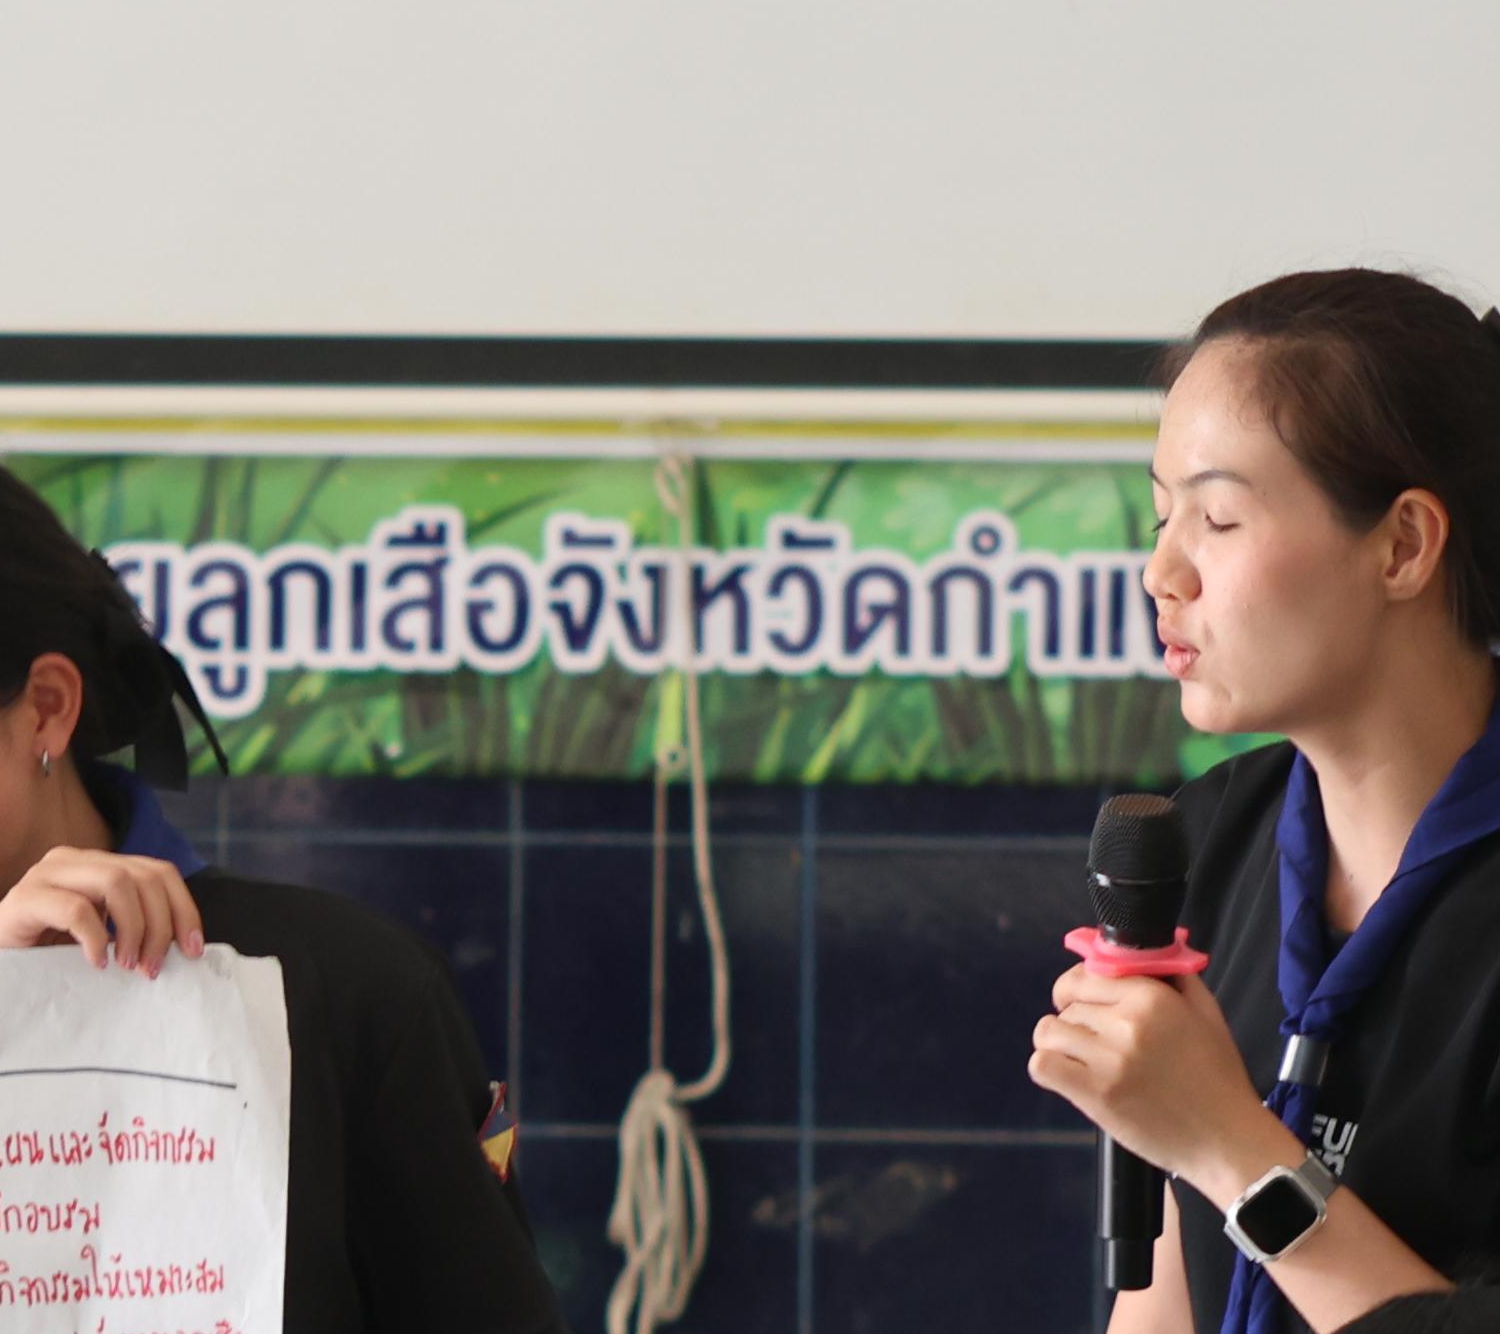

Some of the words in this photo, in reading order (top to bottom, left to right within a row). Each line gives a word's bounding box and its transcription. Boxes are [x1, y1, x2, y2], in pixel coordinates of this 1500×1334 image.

[114, 519, 1167, 699] ยลูกเสือจังหวัดกำแ
